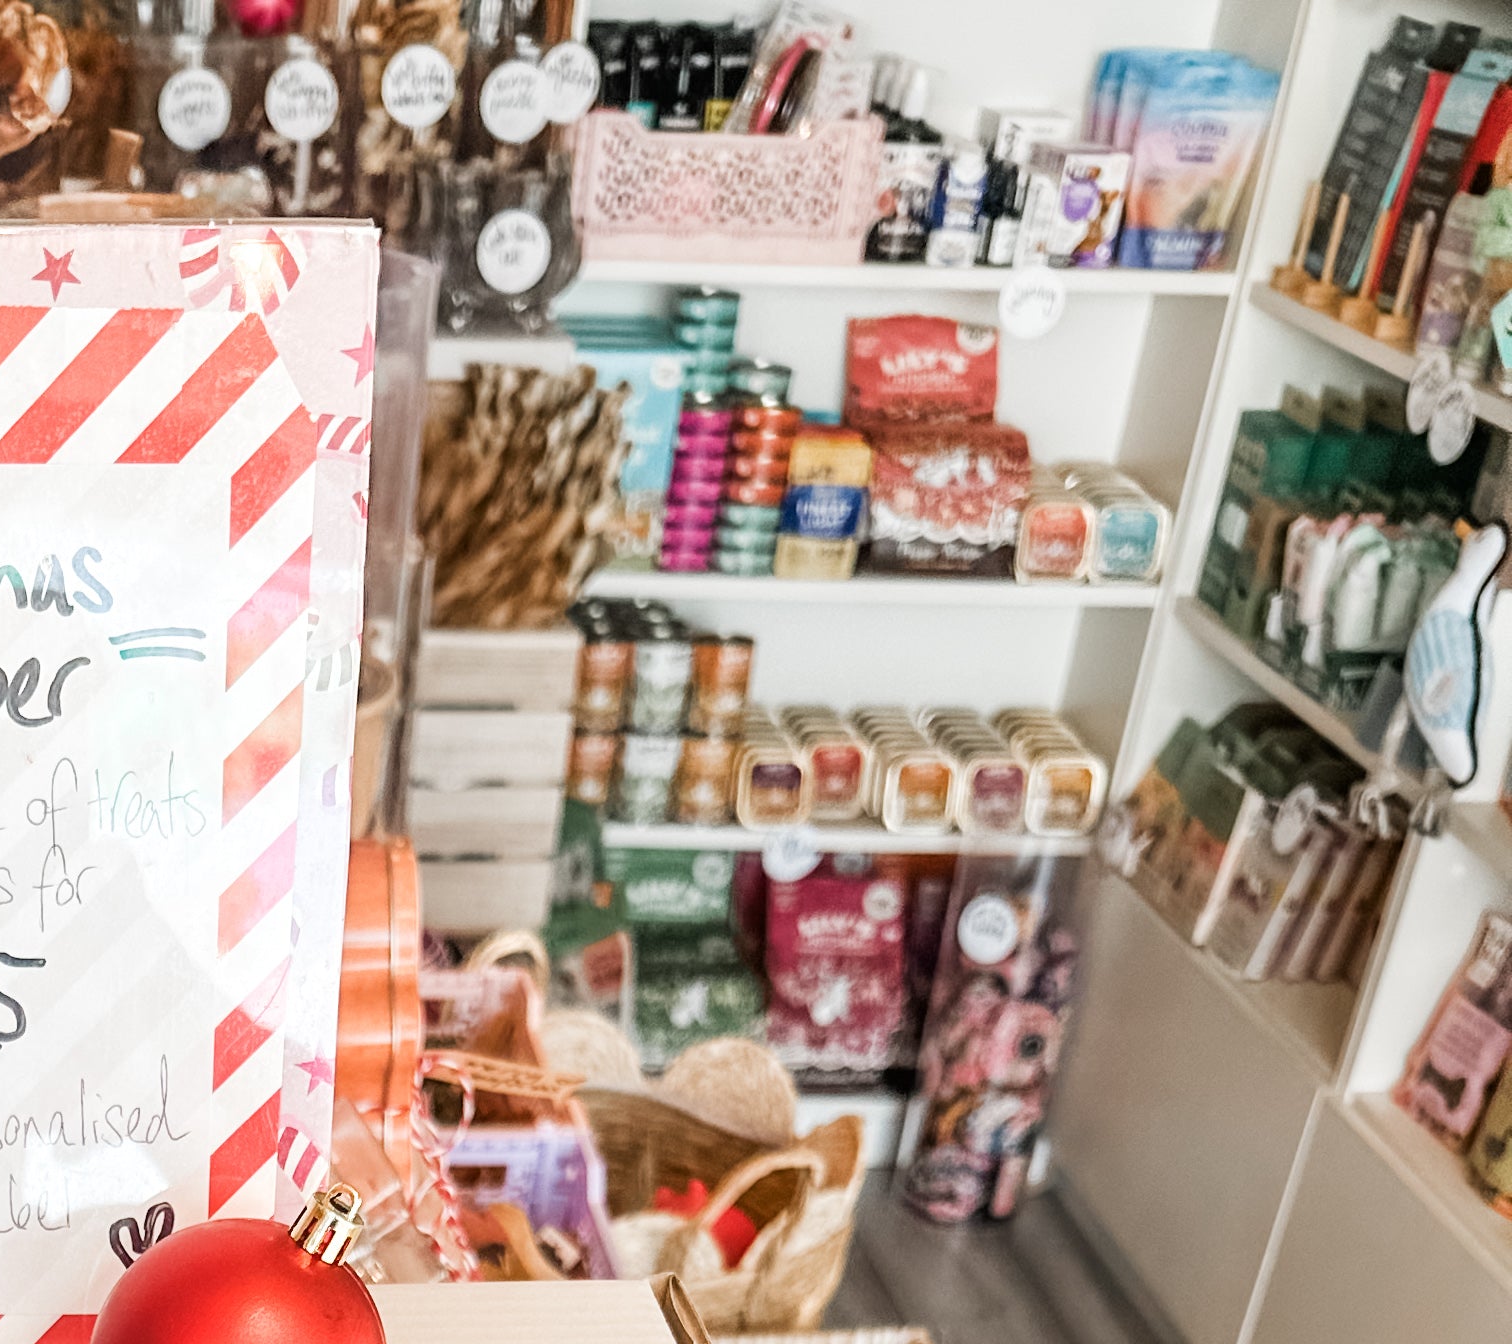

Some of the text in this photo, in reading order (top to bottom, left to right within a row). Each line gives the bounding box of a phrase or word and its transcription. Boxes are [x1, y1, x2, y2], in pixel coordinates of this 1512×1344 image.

[26, 757, 78, 857] of
[87, 751, 207, 839] treats
[33, 843, 98, 933] for
